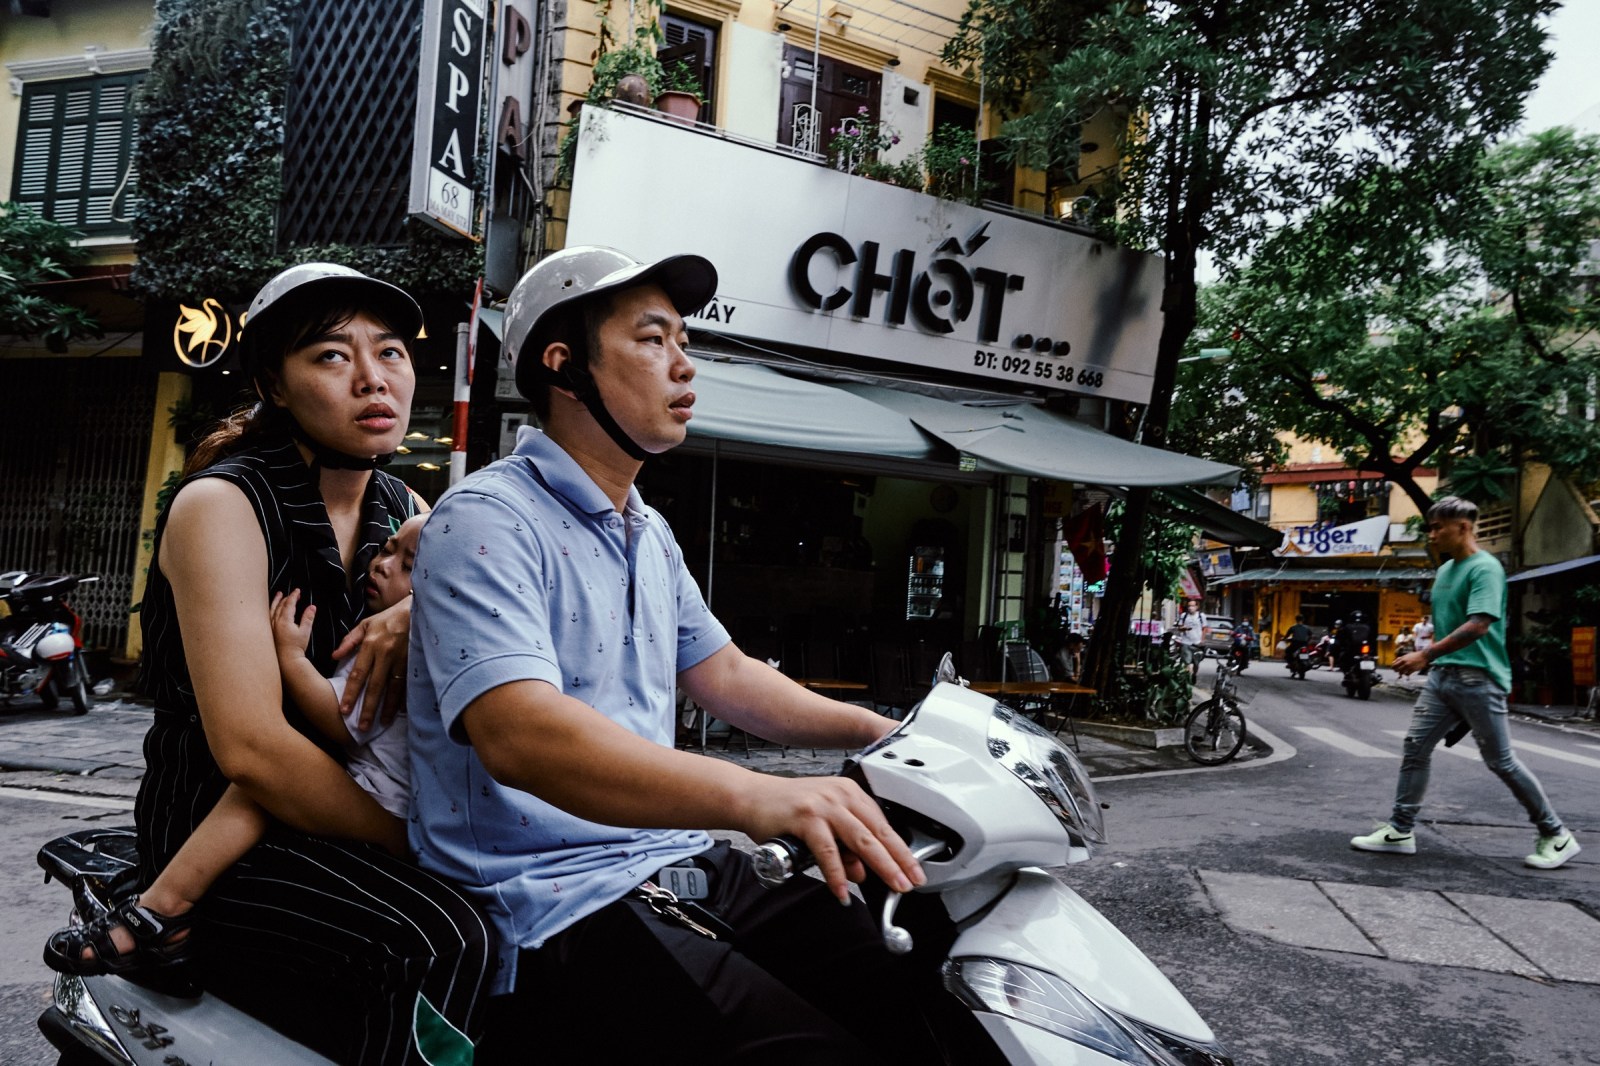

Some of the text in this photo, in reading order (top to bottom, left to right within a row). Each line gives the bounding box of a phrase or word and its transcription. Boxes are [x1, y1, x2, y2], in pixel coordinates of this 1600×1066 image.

[438, 7, 472, 179] SPA
[441, 182, 459, 209] 68
[973, 350, 1103, 388] ĐT: 092 55 38 668
[1293, 520, 1358, 554] Tiger
